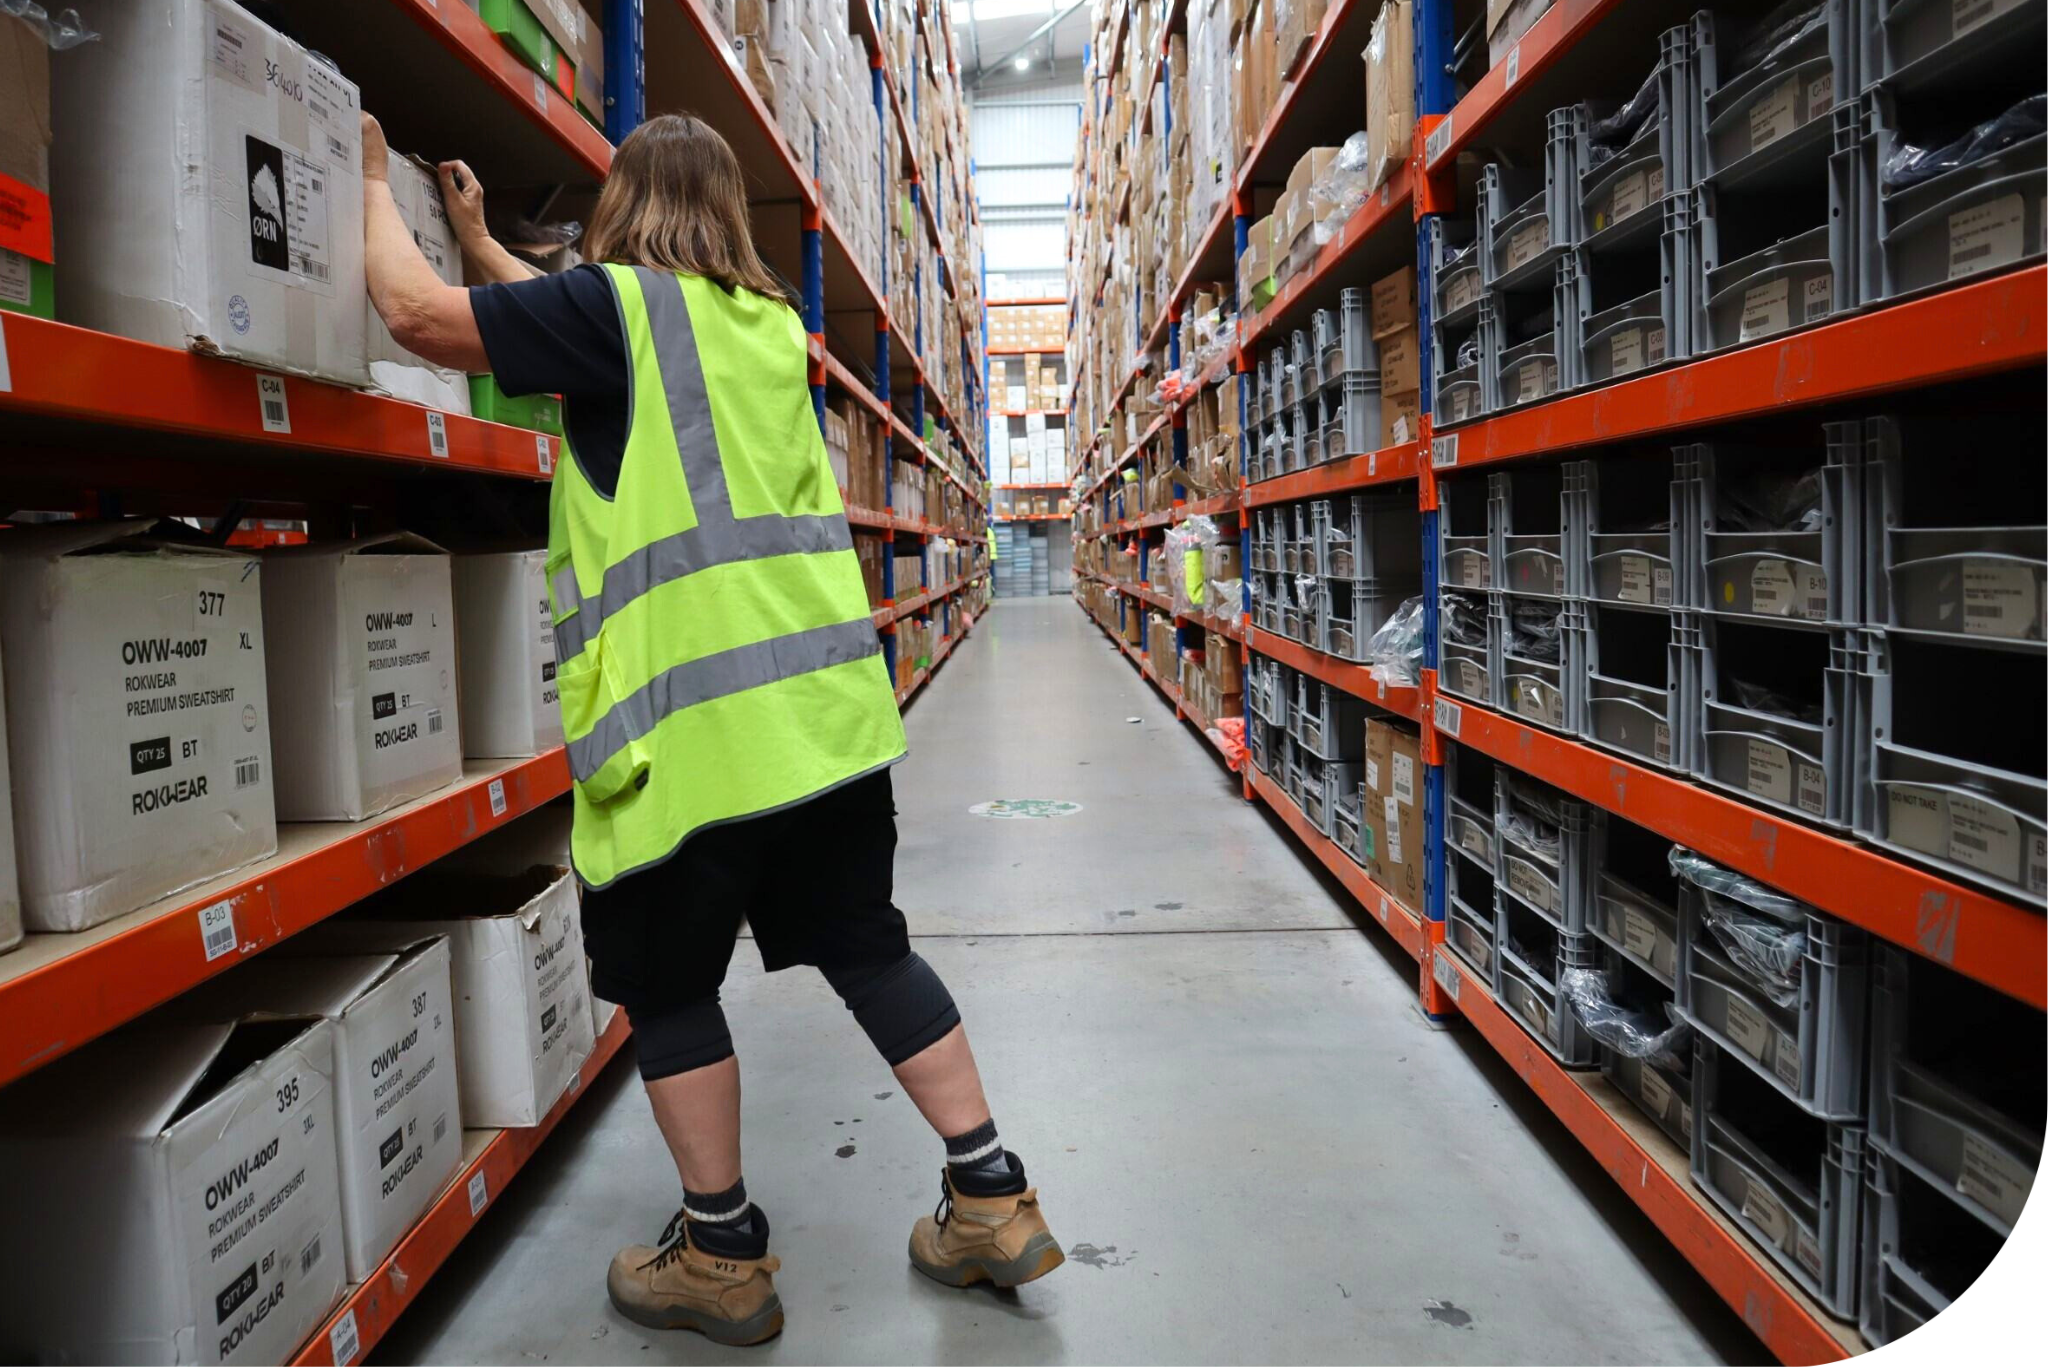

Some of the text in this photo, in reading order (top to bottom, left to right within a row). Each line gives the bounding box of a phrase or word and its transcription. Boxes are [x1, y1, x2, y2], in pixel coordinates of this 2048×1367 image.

[1813, 77, 1831, 97] C-10
[253, 216, 277, 242] ØRN
[1809, 280, 1827, 295] C-04
[262, 379, 280, 394] C-04
[1810, 577, 1827, 590] B-10
[199, 591, 225, 616] 377
[366, 612, 437, 632] OWW-4007 L
[122, 632, 252, 665] OWW-4007 XL
[367, 639, 397, 652] ROKWEAR
[369, 651, 431, 671] PREMIUM SWEATSHIRT
[125, 672, 176, 692] ROKWEAR
[127, 688, 235, 717] PREMIUM SWEATSHIRT
[376, 701, 387, 712] QTY
[401, 694, 410, 707] BT
[375, 723, 418, 749] ROKWEAR
[136, 739, 198, 764] QTY 25 BT
[1803, 768, 1820, 784] B-04
[132, 776, 208, 815] ROKWEAR
[1904, 793, 1918, 807] NOT
[1919, 797, 1938, 811] TAKE
[205, 906, 225, 926] B-03
[412, 991, 426, 1018] 387
[371, 1028, 418, 1078] OWW-4007
[276, 1076, 299, 1113] 395
[374, 1069, 403, 1100] ROKWEAR
[376, 1056, 435, 1121] PREMIUM SWEATSHIRT
[408, 1117, 417, 1137] BT
[205, 1113, 315, 1211] OWW-4007 3XL
[382, 1144, 423, 1199] ROKWEAR
[208, 1192, 255, 1239] ROKWEAR
[211, 1169, 306, 1264] PREMIUM SWEATSHIRT
[715, 1260, 737, 1273] V12
[222, 1249, 276, 1311] QTY 20 BT
[219, 1281, 285, 1362] ROKWEAR
[336, 1318, 351, 1341] A-04
